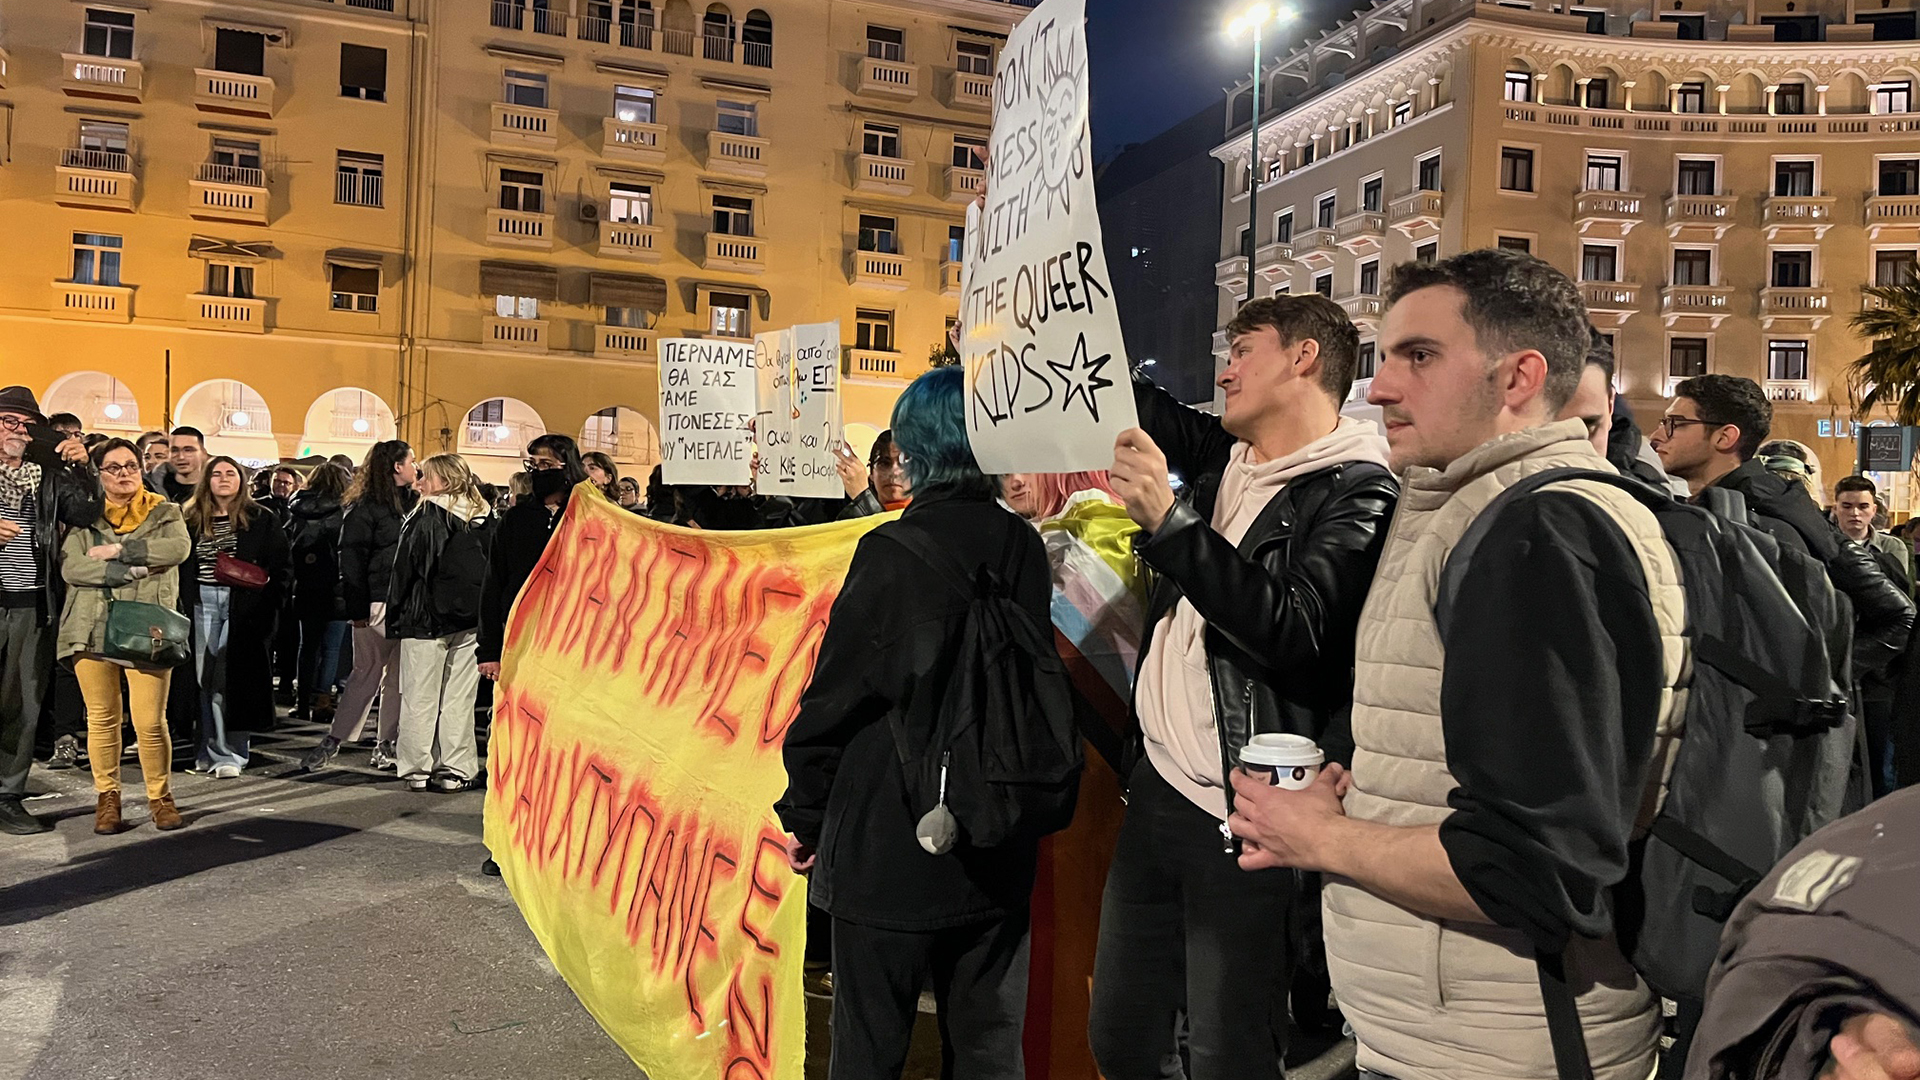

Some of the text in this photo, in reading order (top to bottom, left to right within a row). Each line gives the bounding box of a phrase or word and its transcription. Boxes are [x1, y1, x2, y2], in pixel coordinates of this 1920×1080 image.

[988, 119, 1038, 190] MESS
[980, 180, 1032, 263] WITH
[972, 241, 1108, 336] THE QUEER
[666, 342, 755, 368] ΠΕΡΝΑΜΕ
[668, 368, 736, 388] ΘΑ ΣΑΣ
[972, 341, 1053, 432] KIDS
[660, 389, 698, 407] ΑΜΕ
